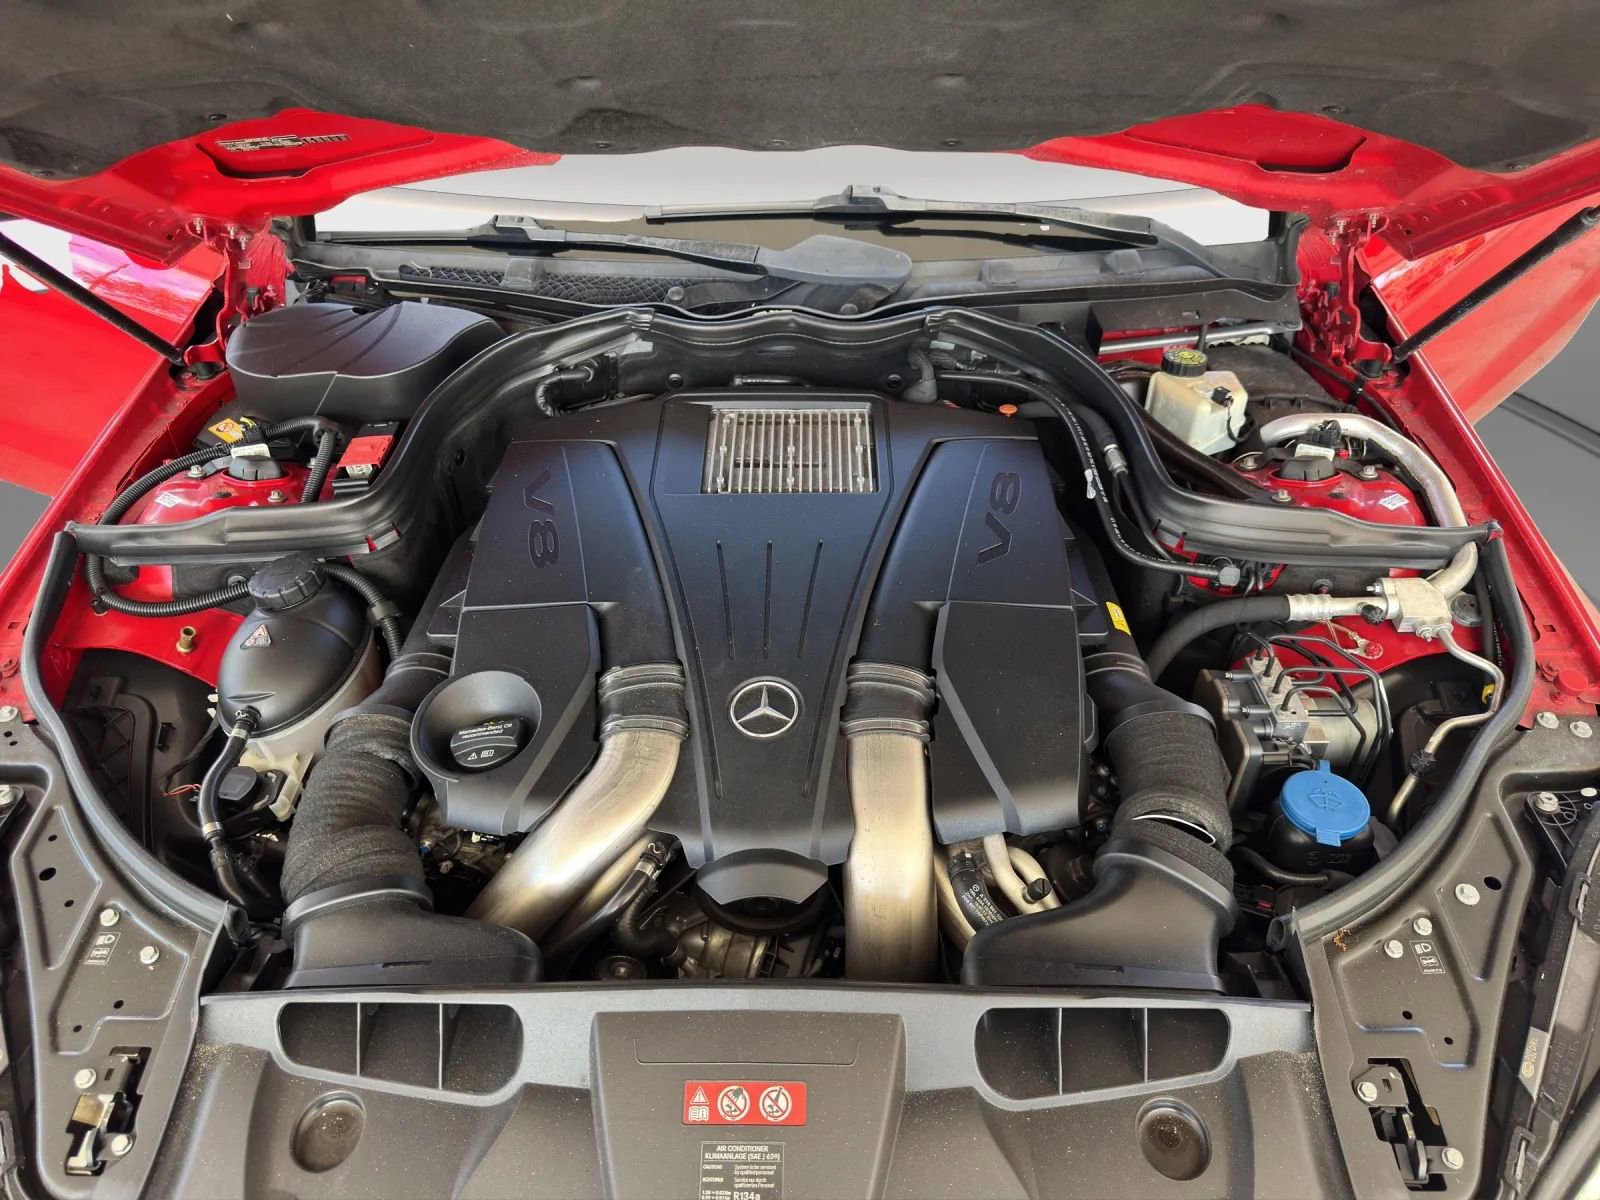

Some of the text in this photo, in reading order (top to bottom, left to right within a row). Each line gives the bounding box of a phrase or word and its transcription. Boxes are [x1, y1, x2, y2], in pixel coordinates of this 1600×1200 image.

[522, 470, 560, 569] V8
[976, 472, 1022, 567] V8
[733, 1192, 760, 1200] R134a
